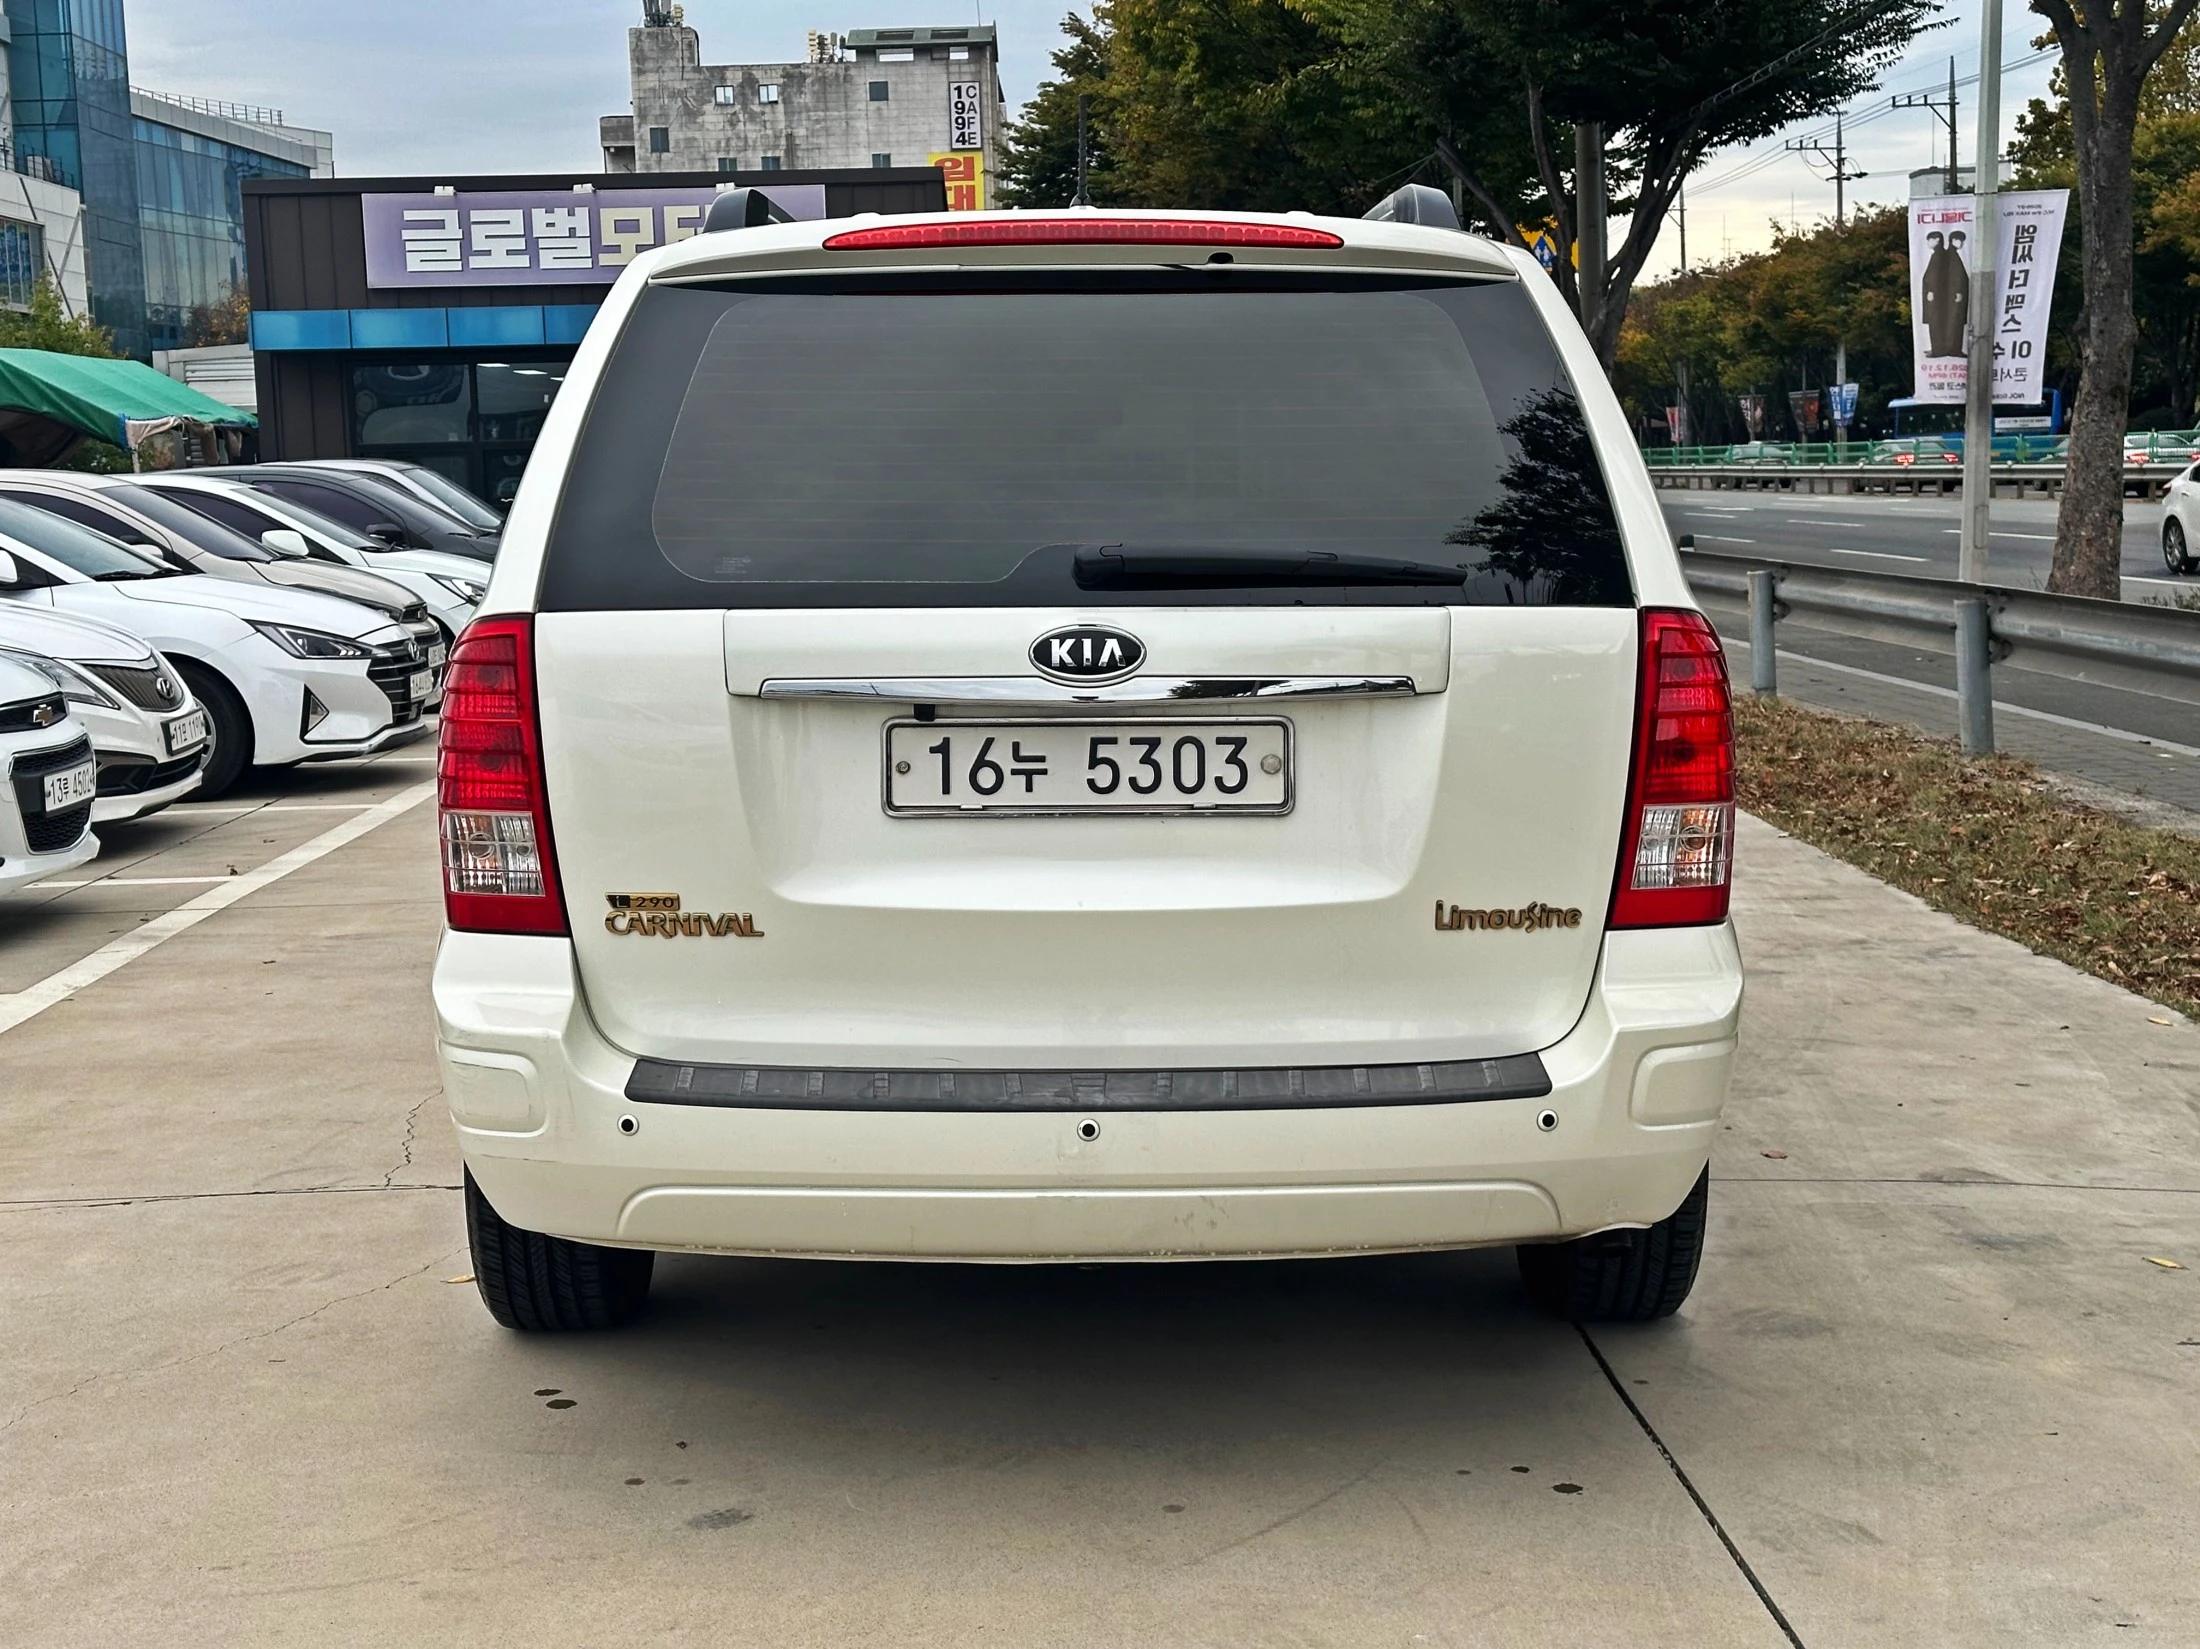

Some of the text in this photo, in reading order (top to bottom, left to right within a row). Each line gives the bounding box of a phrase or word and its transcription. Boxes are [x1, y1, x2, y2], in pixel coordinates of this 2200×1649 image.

[953, 84, 967, 146] 1994
[966, 84, 978, 146] CAFE
[1049, 637, 1127, 668] KIA
[928, 735, 1249, 796] 16누 5303
[636, 896, 675, 909] 290
[1435, 899, 1582, 933] Limousine
[604, 911, 765, 939] CARNIVAL
